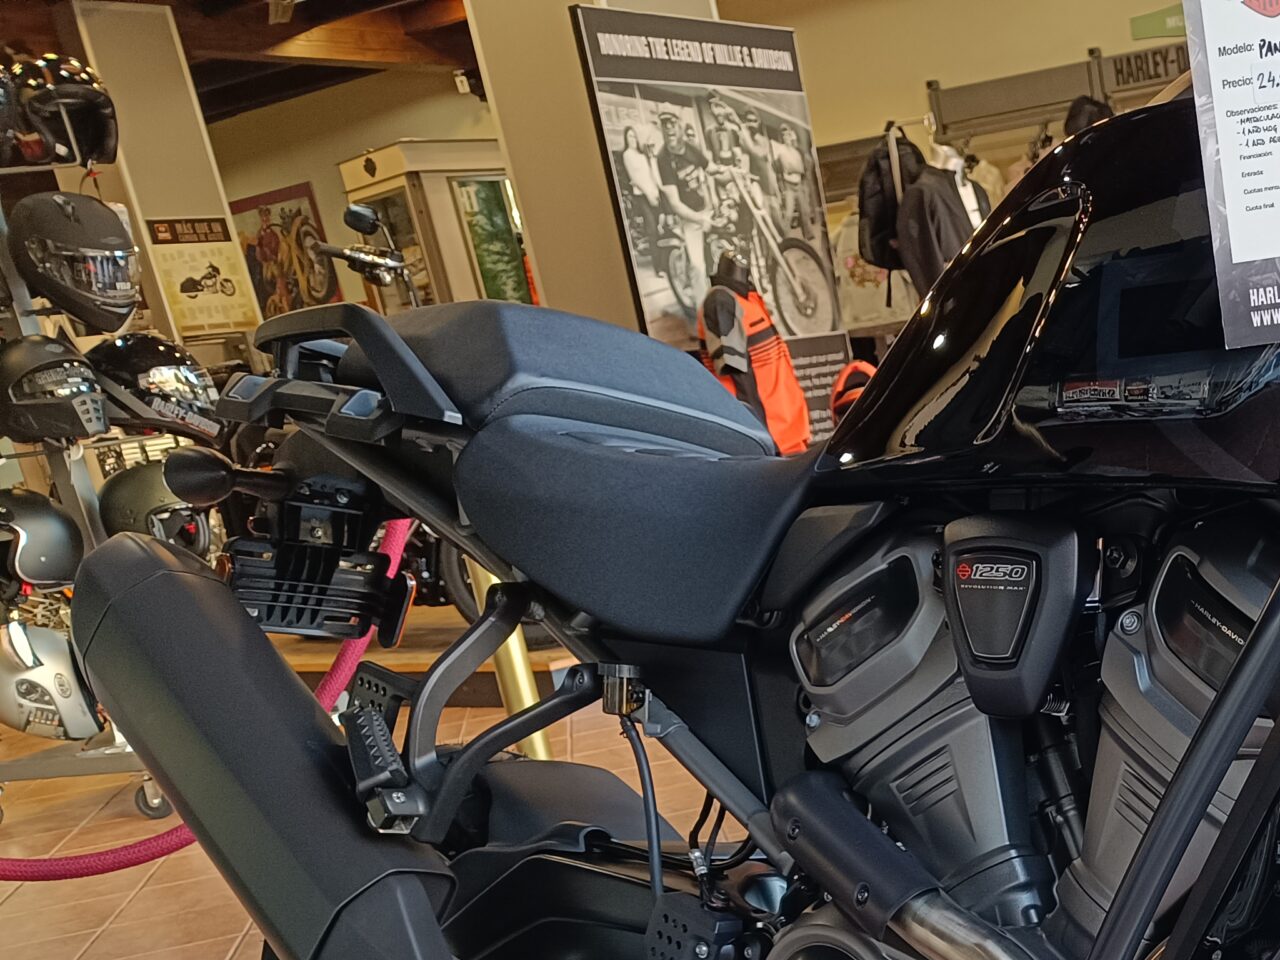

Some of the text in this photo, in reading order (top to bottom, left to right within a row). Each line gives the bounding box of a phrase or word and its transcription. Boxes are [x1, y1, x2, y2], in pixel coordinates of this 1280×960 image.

[668, 39, 703, 63] LEGEND
[1218, 42, 1254, 57] Modelo:
[1222, 77, 1253, 90] Precio:
[1243, 187, 1264, 195] Cuotas
[1245, 204, 1262, 212] Cuota
[971, 563, 1028, 581] 1250
[1194, 603, 1246, 646] HARLEY-DAVID
